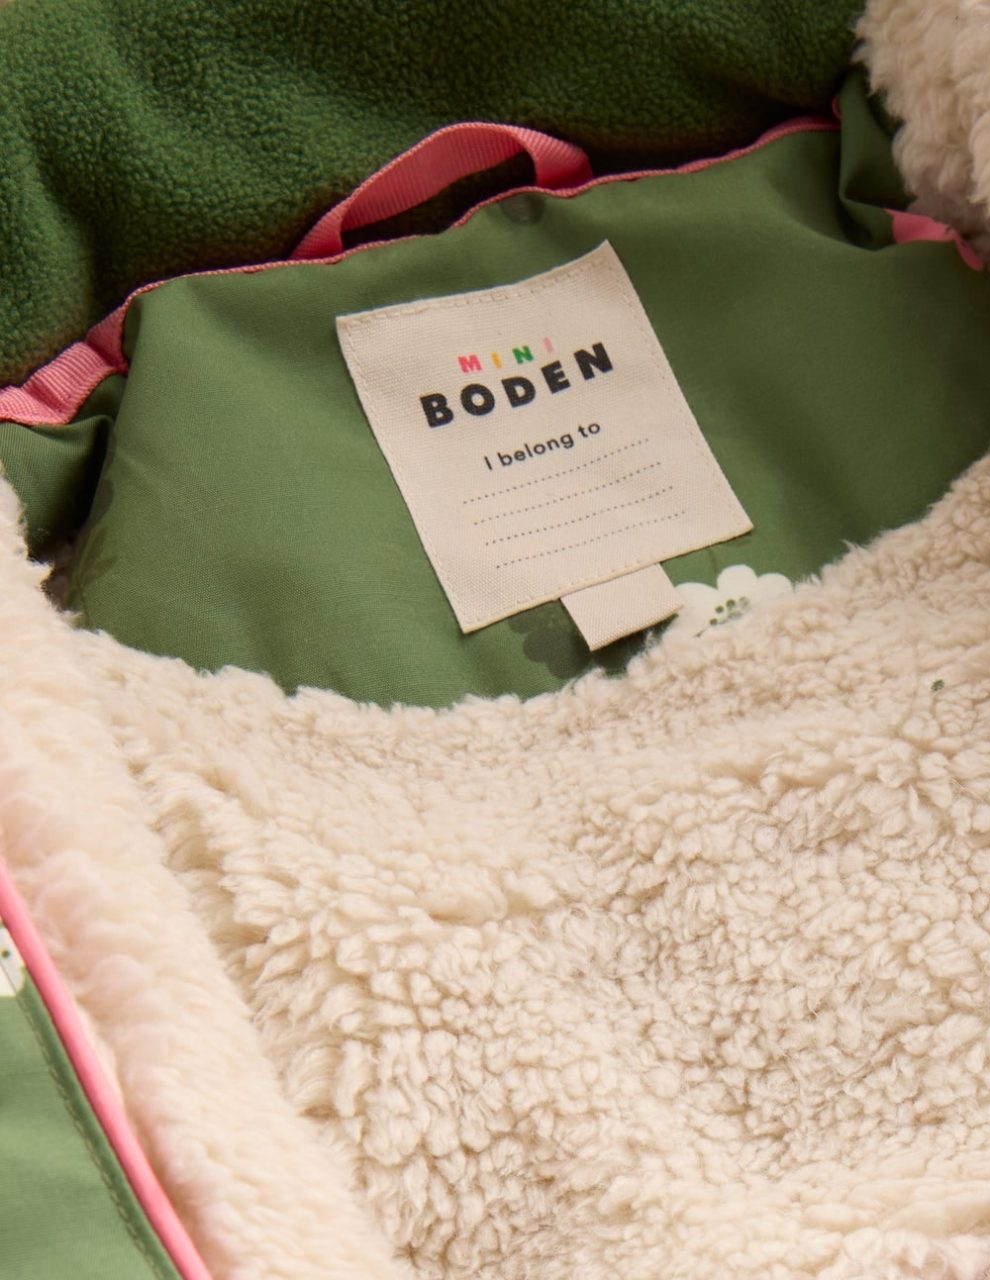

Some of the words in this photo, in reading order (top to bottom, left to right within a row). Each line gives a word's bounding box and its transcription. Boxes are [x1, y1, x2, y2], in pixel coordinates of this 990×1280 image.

[458, 336, 555, 374] MINI
[420, 342, 613, 428] BODEN
[484, 455, 494, 471] I
[498, 433, 575, 467] belong
[578, 422, 601, 438] to
